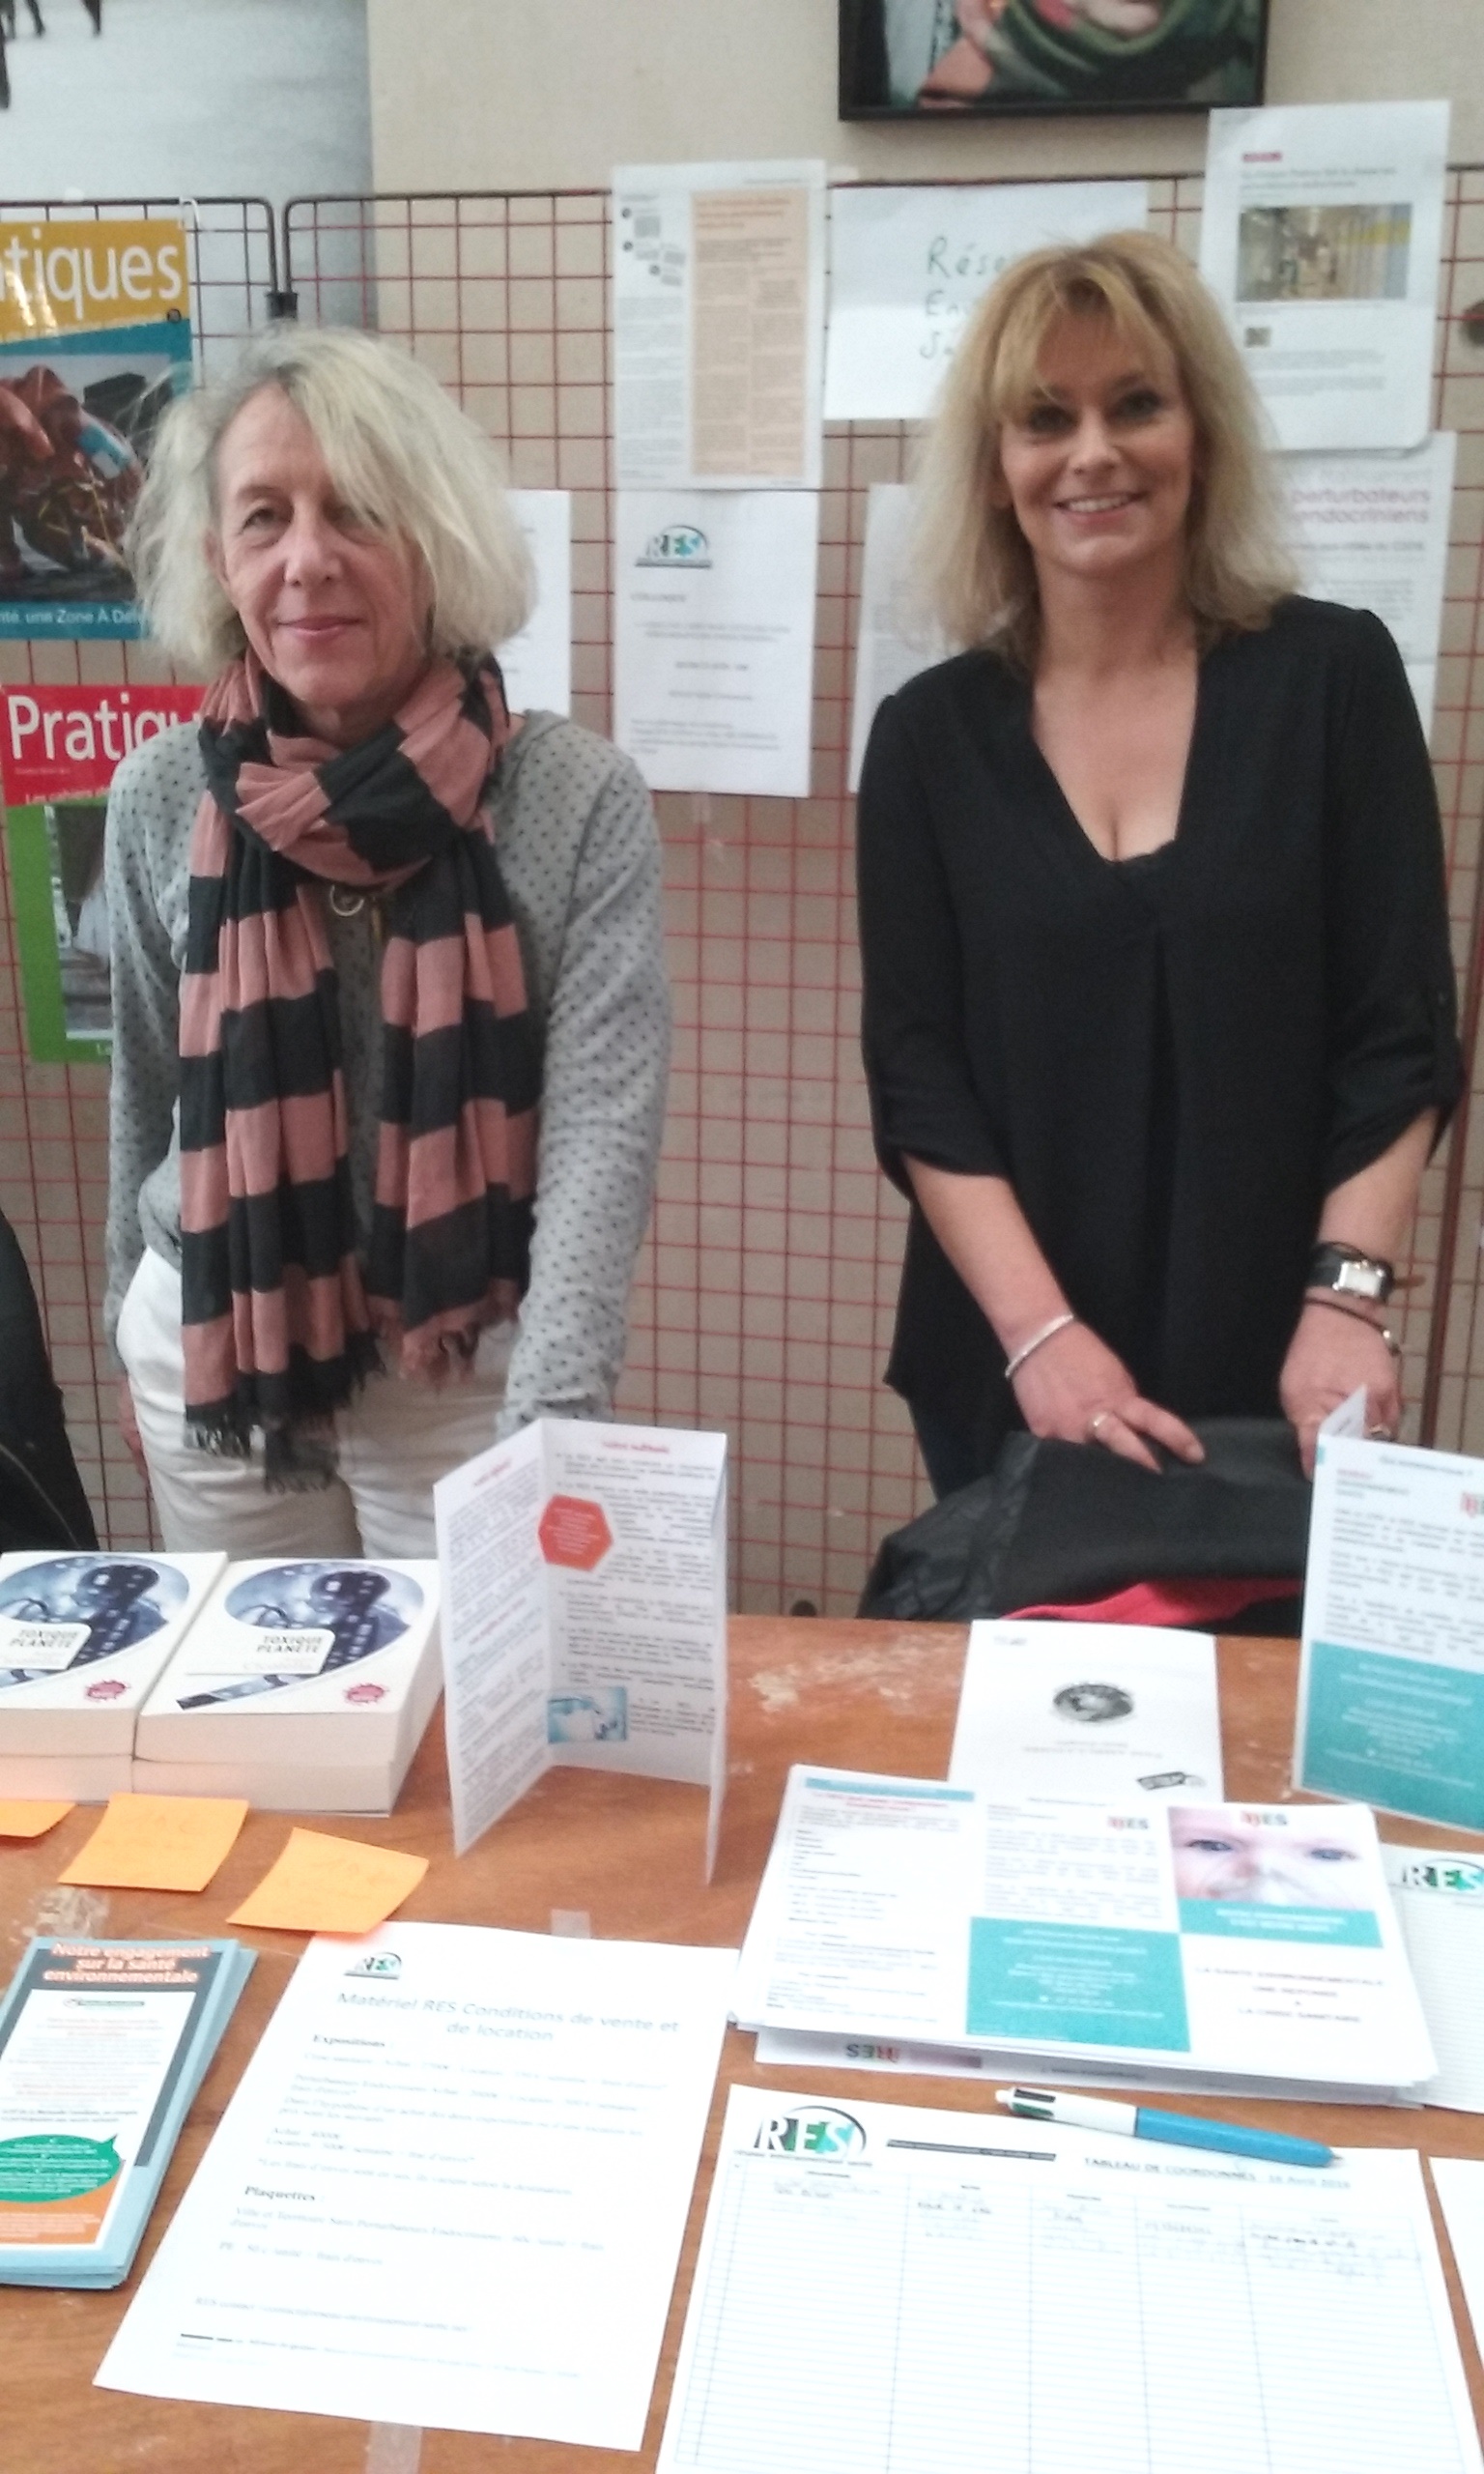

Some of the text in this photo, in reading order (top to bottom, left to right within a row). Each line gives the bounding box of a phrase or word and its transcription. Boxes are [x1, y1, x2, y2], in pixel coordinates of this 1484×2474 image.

[0, 228, 183, 319] tiques
[8, 690, 202, 761] Pratiq
[336, 1993, 681, 2033] Matériel RES Conditions de vente et
[446, 2021, 555, 2041] de location
[755, 2115, 854, 2154] RES
